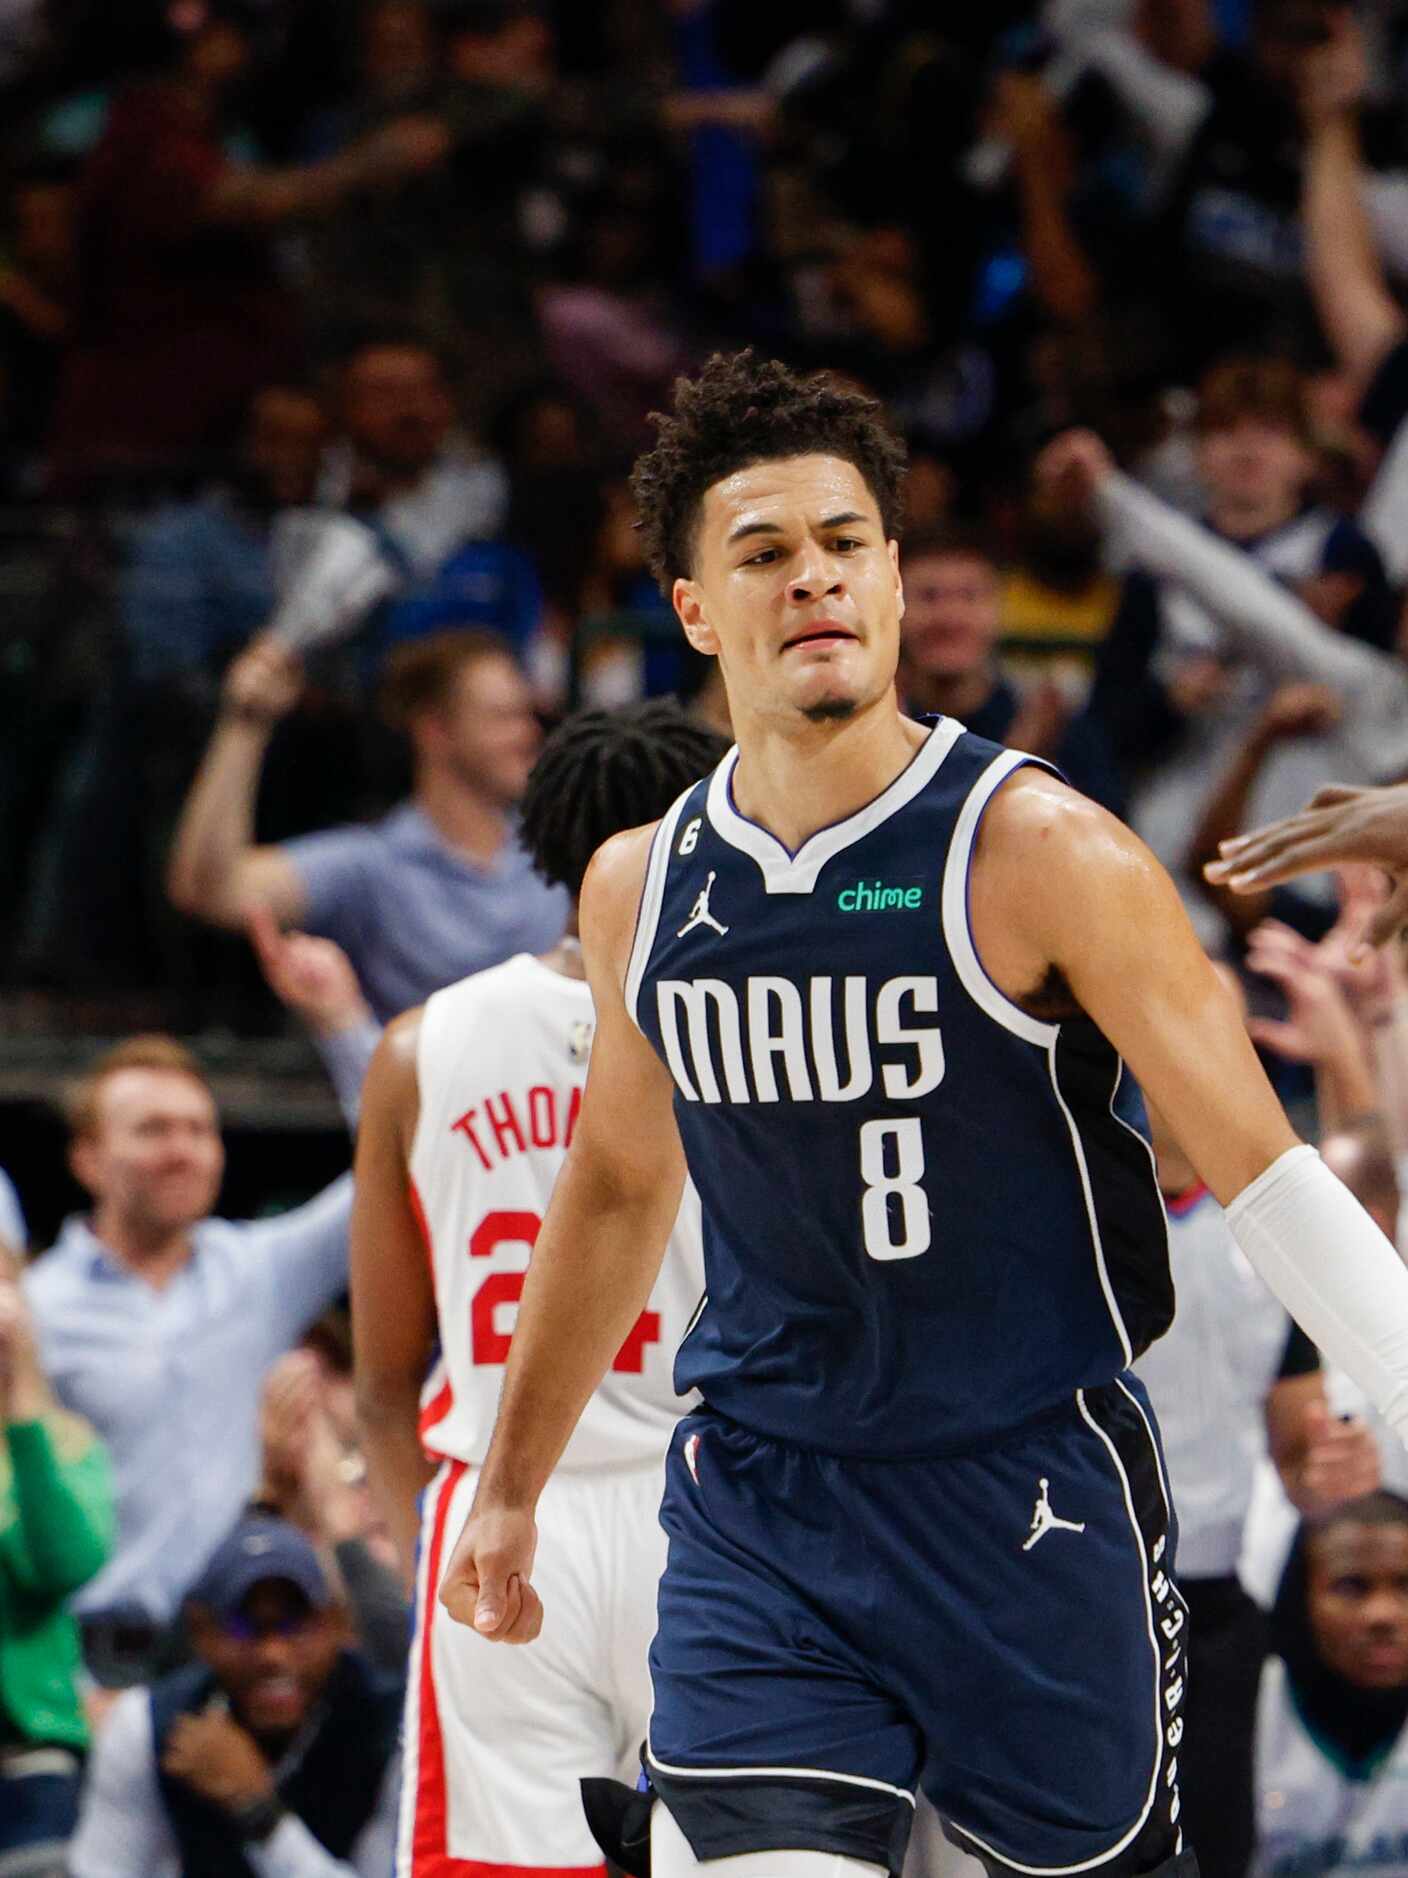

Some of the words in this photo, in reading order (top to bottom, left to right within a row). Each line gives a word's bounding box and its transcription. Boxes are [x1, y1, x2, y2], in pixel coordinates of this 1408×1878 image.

[678, 817, 702, 855] 6
[838, 881, 922, 912] chime
[860, 1117, 931, 1261] 8
[1151, 1533, 1185, 1857] AVERICKS
